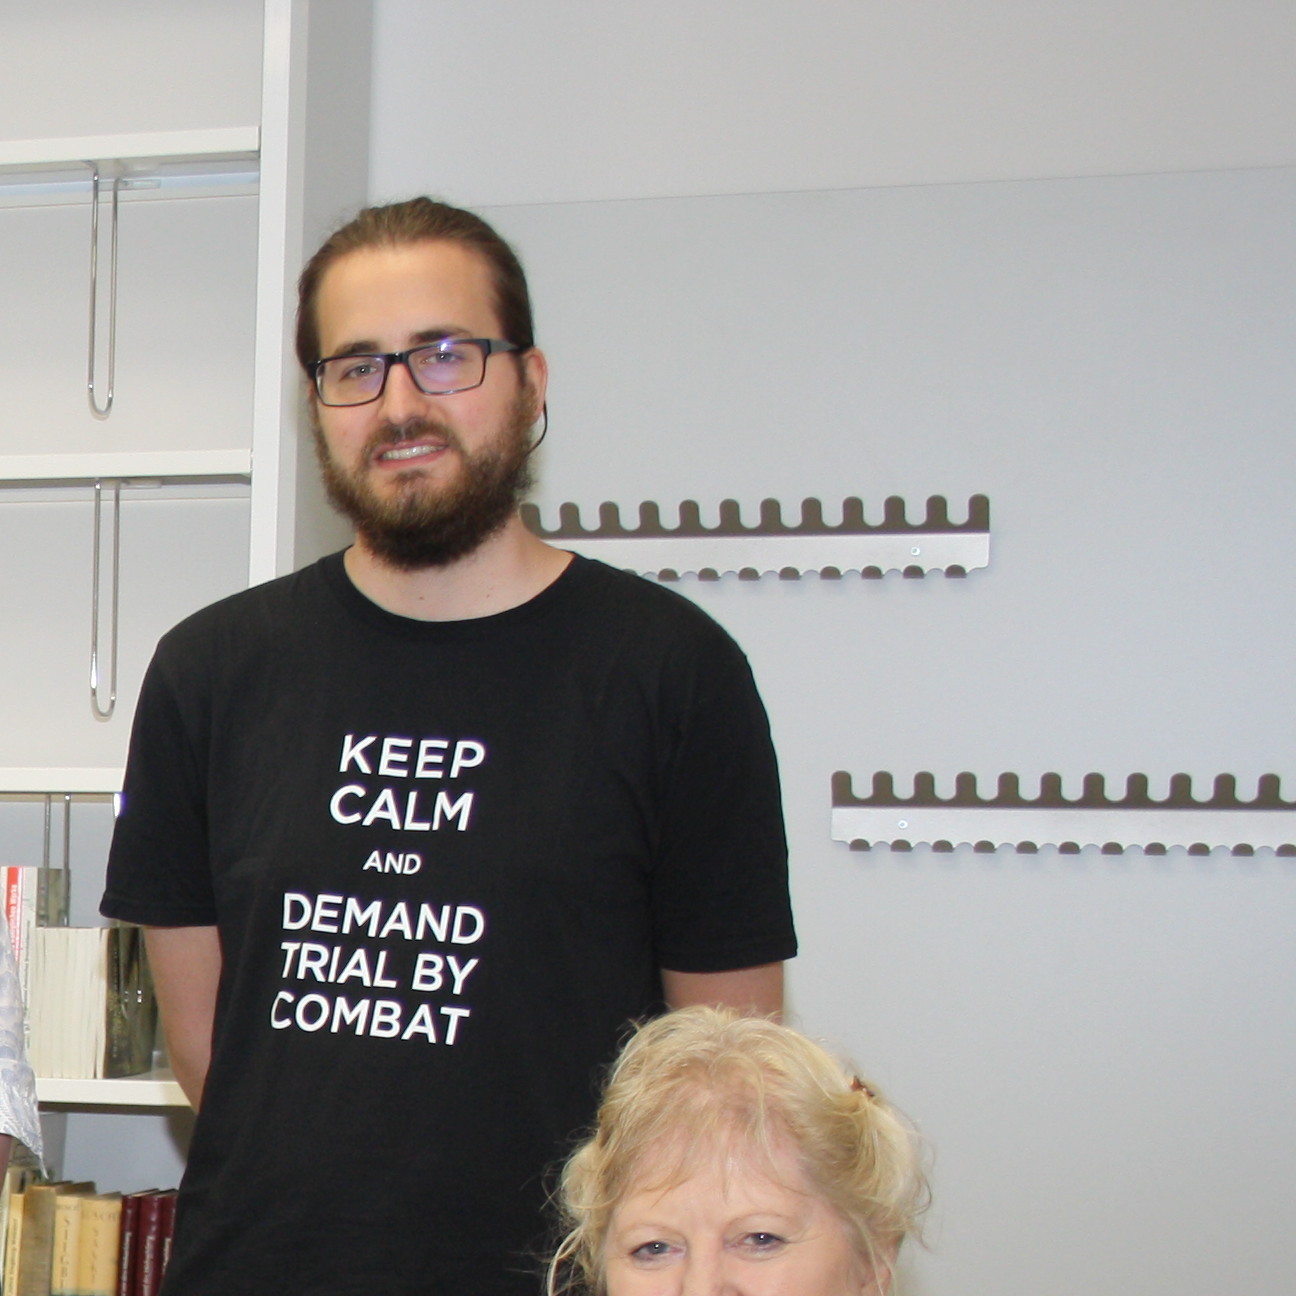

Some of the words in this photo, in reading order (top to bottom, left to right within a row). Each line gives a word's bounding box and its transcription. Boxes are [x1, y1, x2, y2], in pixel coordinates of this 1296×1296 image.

[339, 734, 485, 779] KEEP
[330, 785, 474, 832] CALM
[363, 850, 422, 875] AND
[282, 893, 485, 945] DEMAND
[281, 942, 397, 989] TRIAL
[412, 953, 479, 995] BY
[271, 991, 470, 1045] COMBAT
